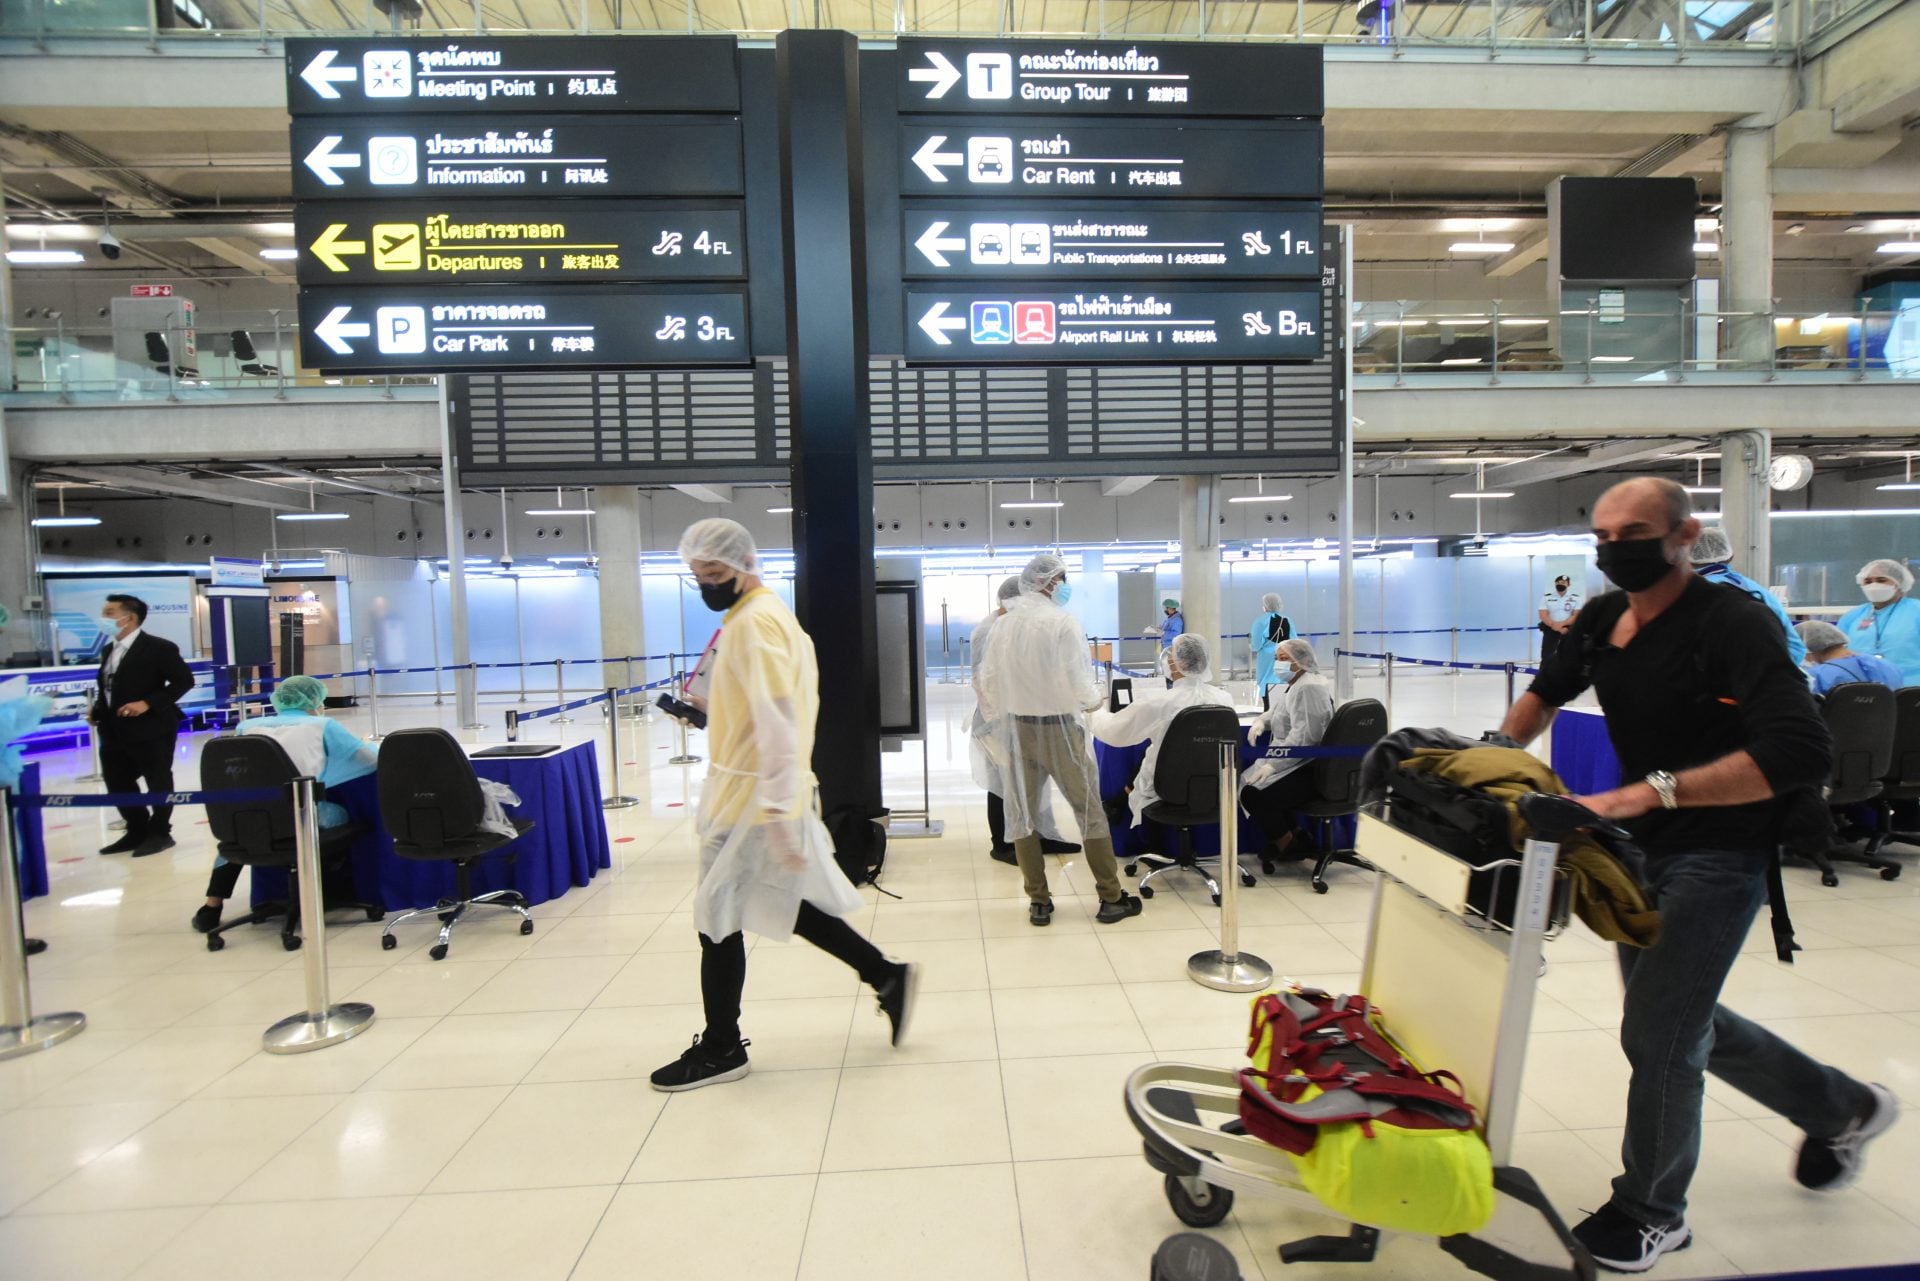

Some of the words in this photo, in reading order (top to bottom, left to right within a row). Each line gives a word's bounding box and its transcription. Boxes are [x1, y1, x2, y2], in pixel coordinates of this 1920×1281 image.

[417, 45, 500, 70] จุดนัดพบ
[1019, 46, 1159, 72] คณะนักท่องเที่ยว
[418, 79, 487, 101] Meeting
[491, 79, 536, 97] Point
[567, 78, 618, 95] 约见点
[1020, 83, 1072, 103] Group
[1075, 83, 1111, 101] Tour
[426, 129, 553, 154] ประชาสัมพันธ์
[1020, 134, 1070, 155] รถเช่า
[427, 167, 525, 185] Information
[1022, 167, 1056, 185] Car
[1059, 167, 1095, 185] Rent
[1128, 170, 1182, 186] 汽车出租
[425, 214, 564, 246] ผู้โดยสารขาออก
[427, 254, 523, 276] Departures
[562, 254, 619, 270] 旅客出发
[1053, 252, 1084, 265] Public
[1086, 252, 1163, 267] Transportations
[431, 304, 546, 321] อาคารจอดรถ
[432, 335, 467, 353] Car
[469, 334, 509, 352] Park
[1060, 331, 1097, 346] Airport
[1099, 331, 1123, 343] Rail
[1125, 331, 1149, 343] Link
[1265, 748, 1291, 757] AOT
[46, 796, 74, 806] AOT
[166, 793, 193, 804] AOT
